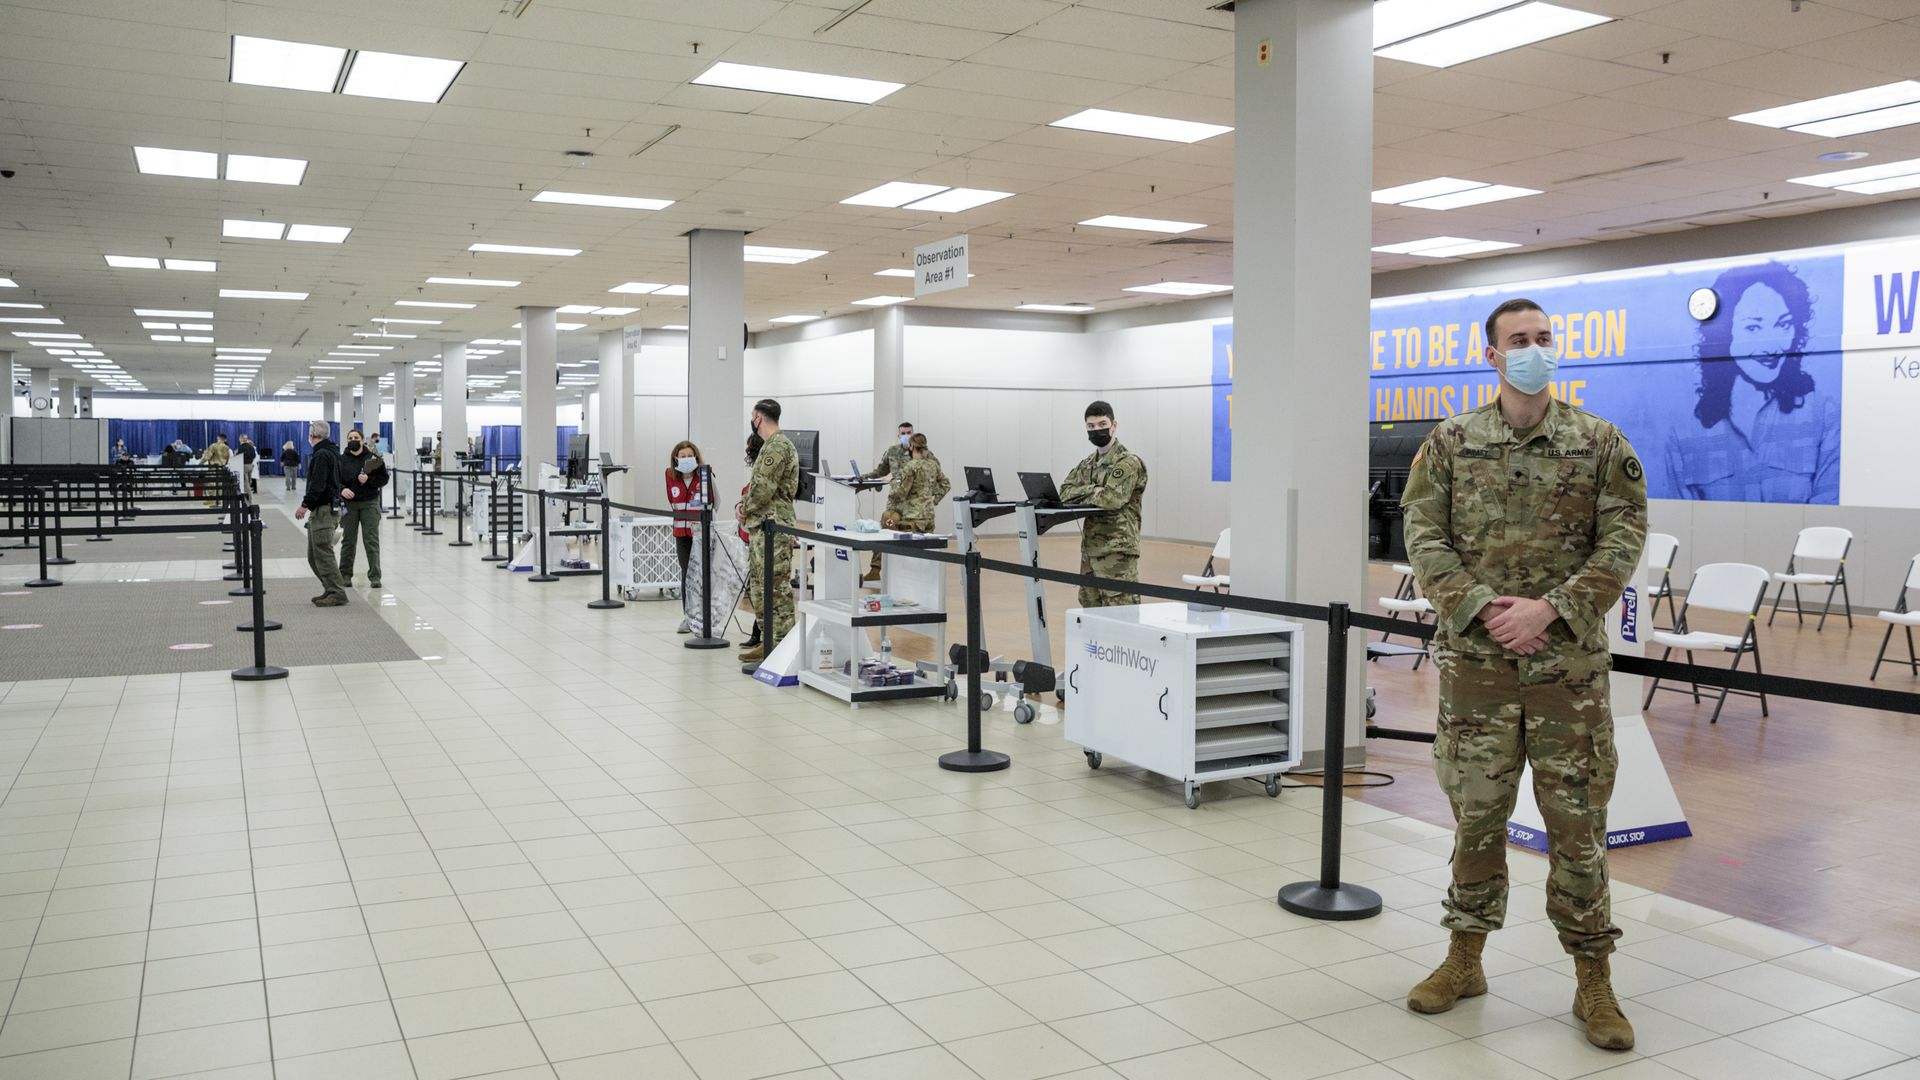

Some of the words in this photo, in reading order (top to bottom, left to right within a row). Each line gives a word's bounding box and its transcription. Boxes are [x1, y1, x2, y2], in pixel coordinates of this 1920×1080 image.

[916, 245, 965, 267] Observation
[925, 271, 943, 285] Area
[945, 265, 954, 281] #1
[1391, 326, 1422, 369] TO
[1428, 323, 1460, 368] BE
[1464, 321, 1483, 366] A
[1549, 308, 1627, 360] GEON
[1376, 384, 1455, 422] HANDS
[1548, 449, 1562, 457] U.S.
[1564, 448, 1589, 457] ARMY
[1622, 590, 1636, 637] Purell
[1084, 639, 1157, 677] HealthWay
[1515, 830, 1534, 841] STOP
[1608, 833, 1629, 845] QUICK
[1629, 831, 1646, 842] STOP
